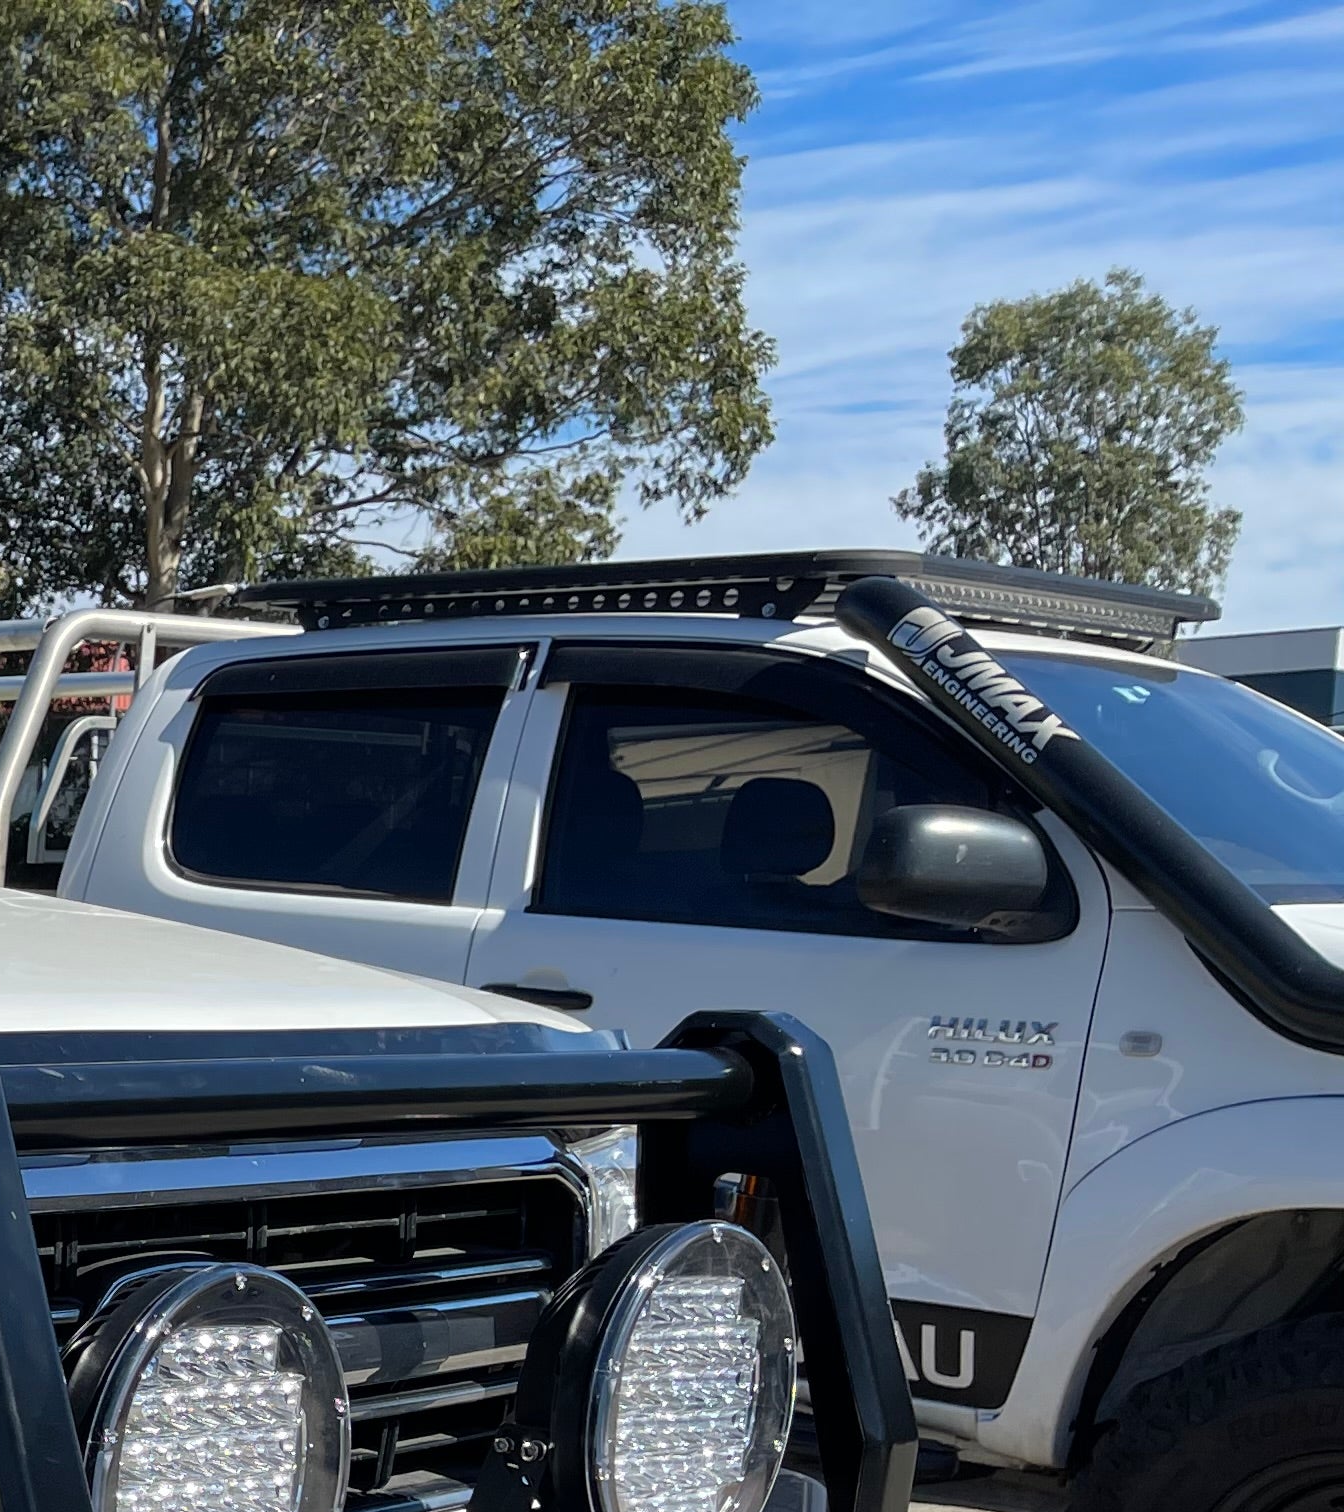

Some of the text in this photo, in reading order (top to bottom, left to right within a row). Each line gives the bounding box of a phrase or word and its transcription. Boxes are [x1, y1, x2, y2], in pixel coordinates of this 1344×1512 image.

[922, 661, 1038, 765] ENGINEERING
[936, 642, 1081, 750] JMAX
[927, 1015, 1059, 1045] HILUX
